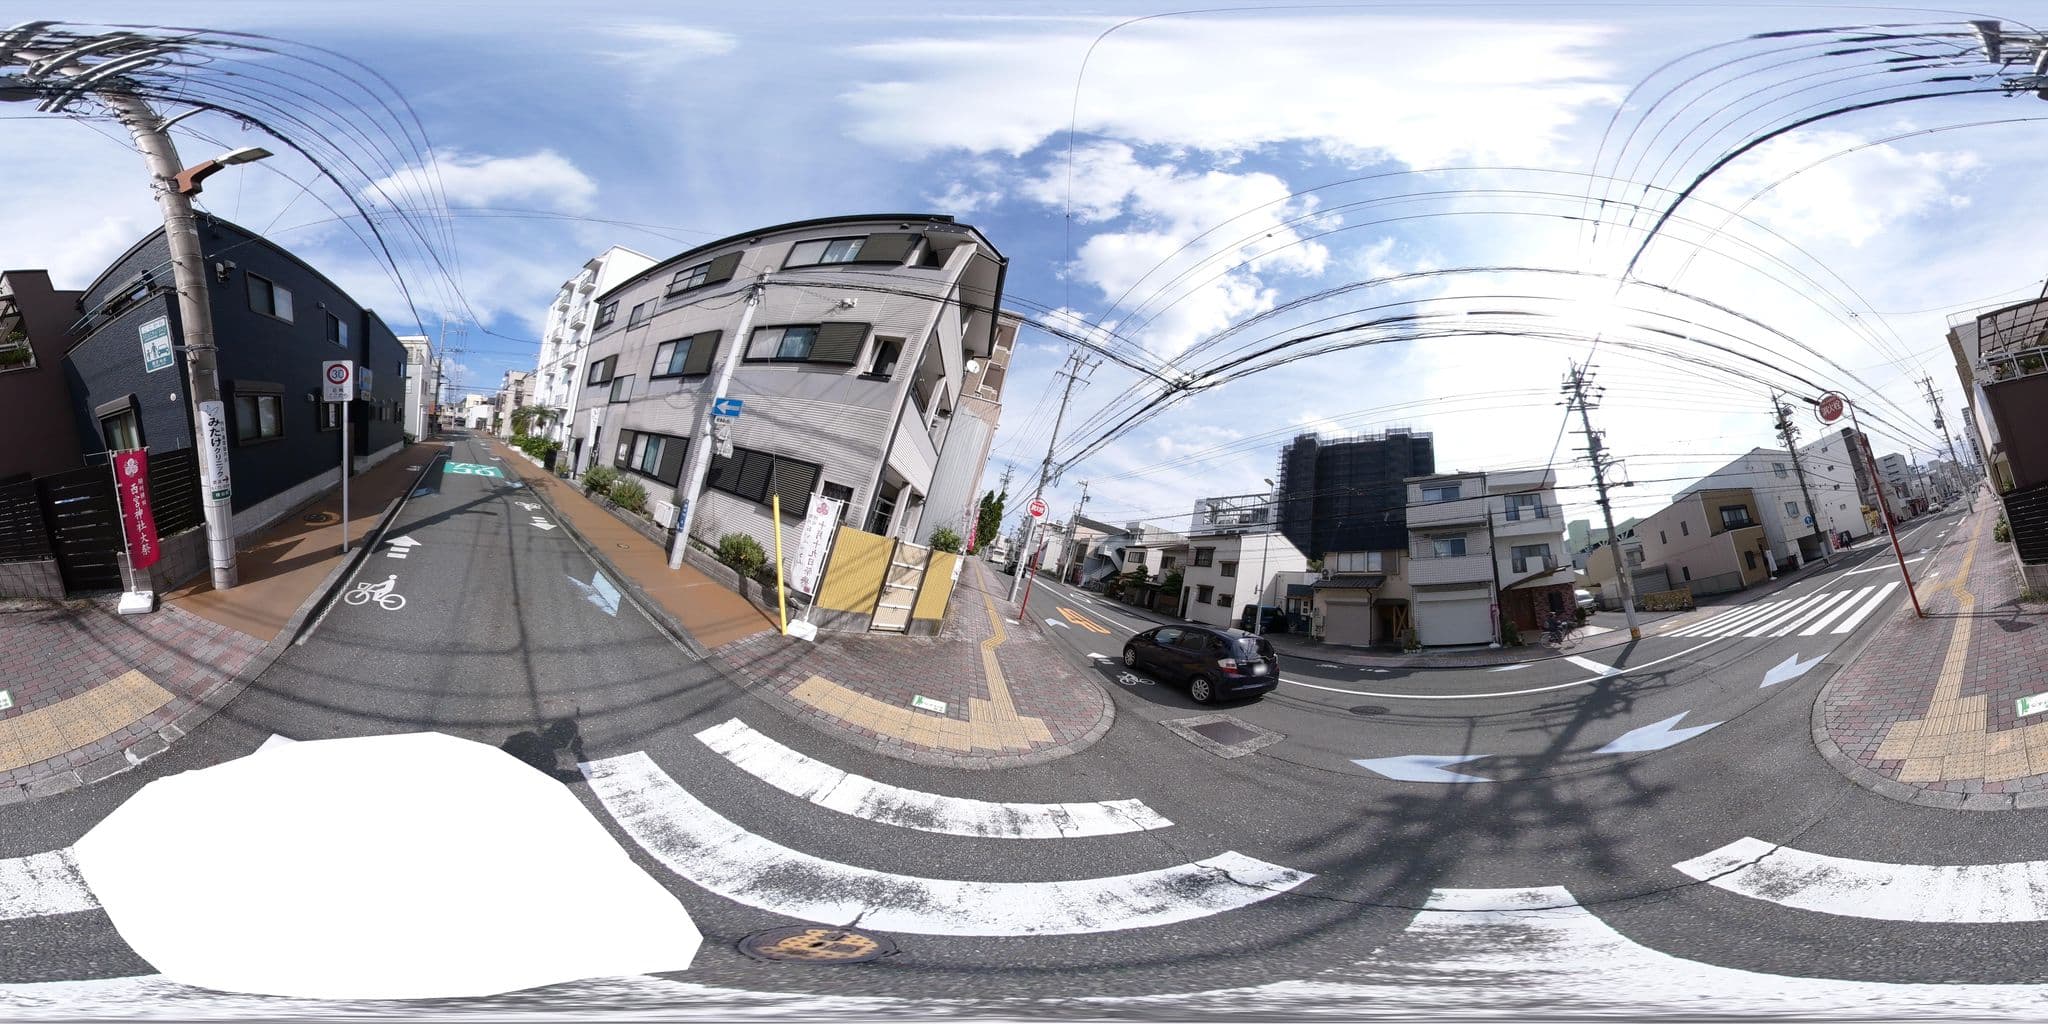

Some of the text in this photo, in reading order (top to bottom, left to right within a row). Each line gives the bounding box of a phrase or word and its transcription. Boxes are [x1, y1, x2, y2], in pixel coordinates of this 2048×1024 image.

[332, 369, 344, 379] 30
[1822, 400, 1841, 415] 消火栓
[208, 417, 224, 478] みたけクリニック
[130, 483, 152, 556] 西宮神社大祭
